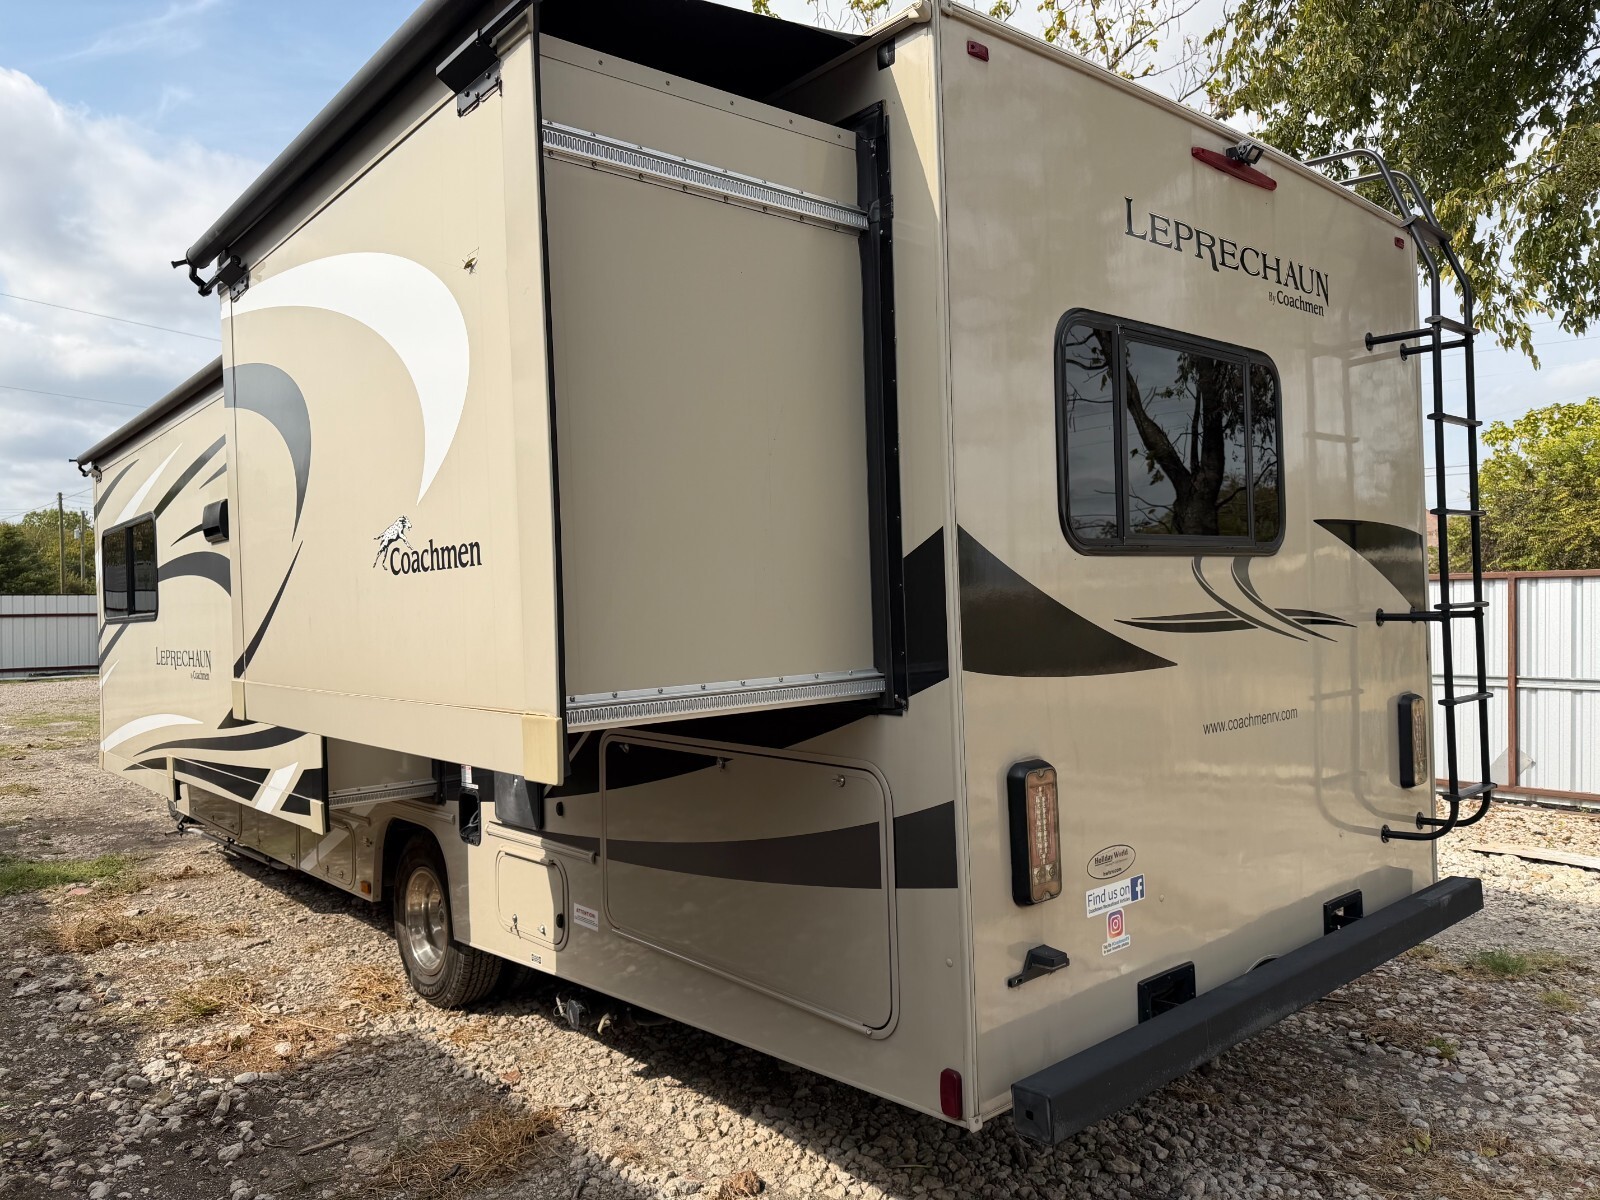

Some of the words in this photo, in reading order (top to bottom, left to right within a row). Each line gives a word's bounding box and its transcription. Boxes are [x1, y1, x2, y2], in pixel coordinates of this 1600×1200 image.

[1124, 196, 1329, 307] LEPRECHAUN
[1268, 291, 1276, 306] By
[1277, 290, 1324, 317] Coachmen
[390, 539, 482, 576] Coachmen
[155, 646, 212, 673] LEPRECHAUN
[1202, 708, 1298, 735] www.coachmenrv.com
[1087, 889, 1106, 908] Find
[1108, 889, 1118, 901] us
[1119, 885, 1131, 897] on
